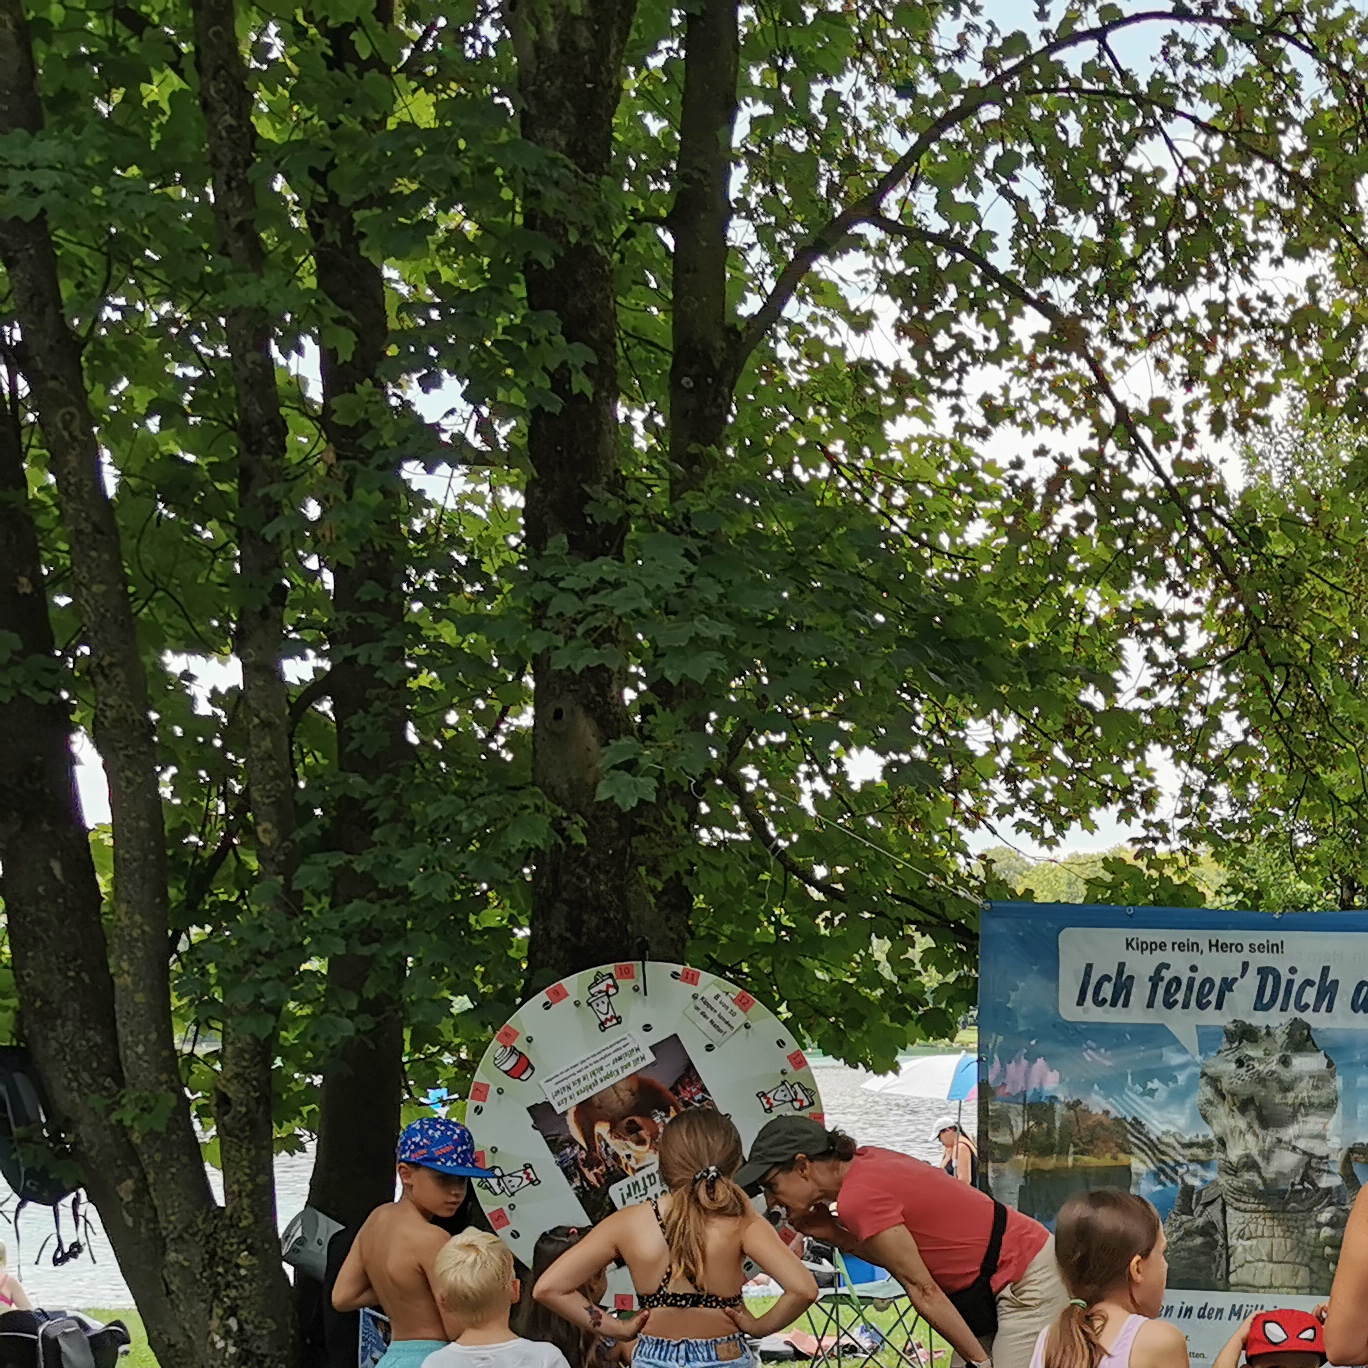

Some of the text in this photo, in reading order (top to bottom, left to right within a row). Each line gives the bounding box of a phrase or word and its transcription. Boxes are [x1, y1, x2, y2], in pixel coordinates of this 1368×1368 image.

[1125, 937, 1285, 956] Kippe rein, Hero sein!
[619, 966, 631, 976] 10
[1075, 961, 1136, 1009] Ich
[1252, 965, 1340, 1014] Dich
[619, 1169, 661, 1206] afür!
[1177, 1301, 1193, 1319] in
[1197, 1302, 1224, 1320] den
[1189, 1351, 1207, 1359] tten.
